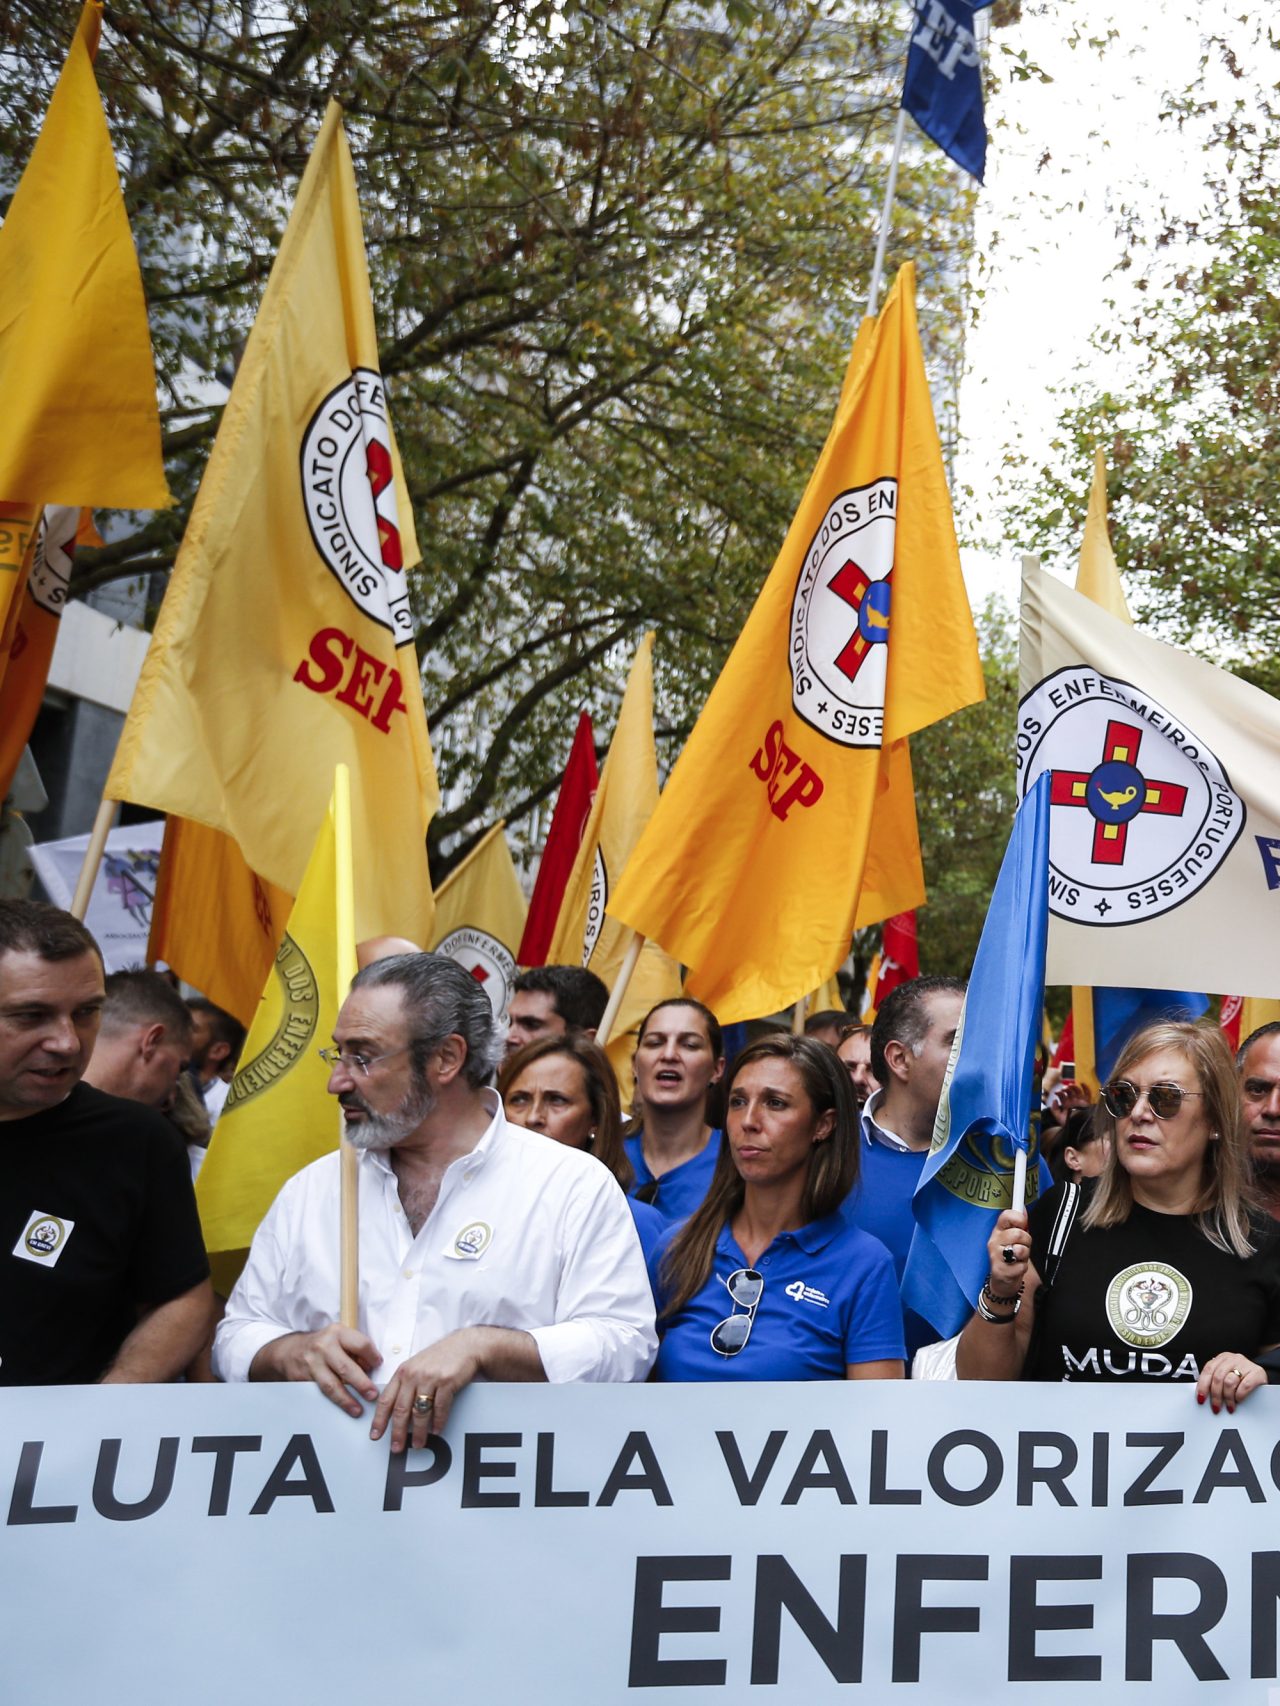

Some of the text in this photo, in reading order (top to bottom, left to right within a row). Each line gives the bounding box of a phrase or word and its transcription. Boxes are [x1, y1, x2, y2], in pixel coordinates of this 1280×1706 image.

[313, 436, 378, 598] SINDICATO
[793, 548, 820, 697] SINDICATO
[822, 501, 861, 547] DOS
[748, 719, 825, 823] SEP
[1127, 781, 1234, 910] PORTUGUESES
[282, 963, 314, 1004] DOS
[6, 1433, 336, 1526] LUTA
[382, 1430, 675, 1512] PELA
